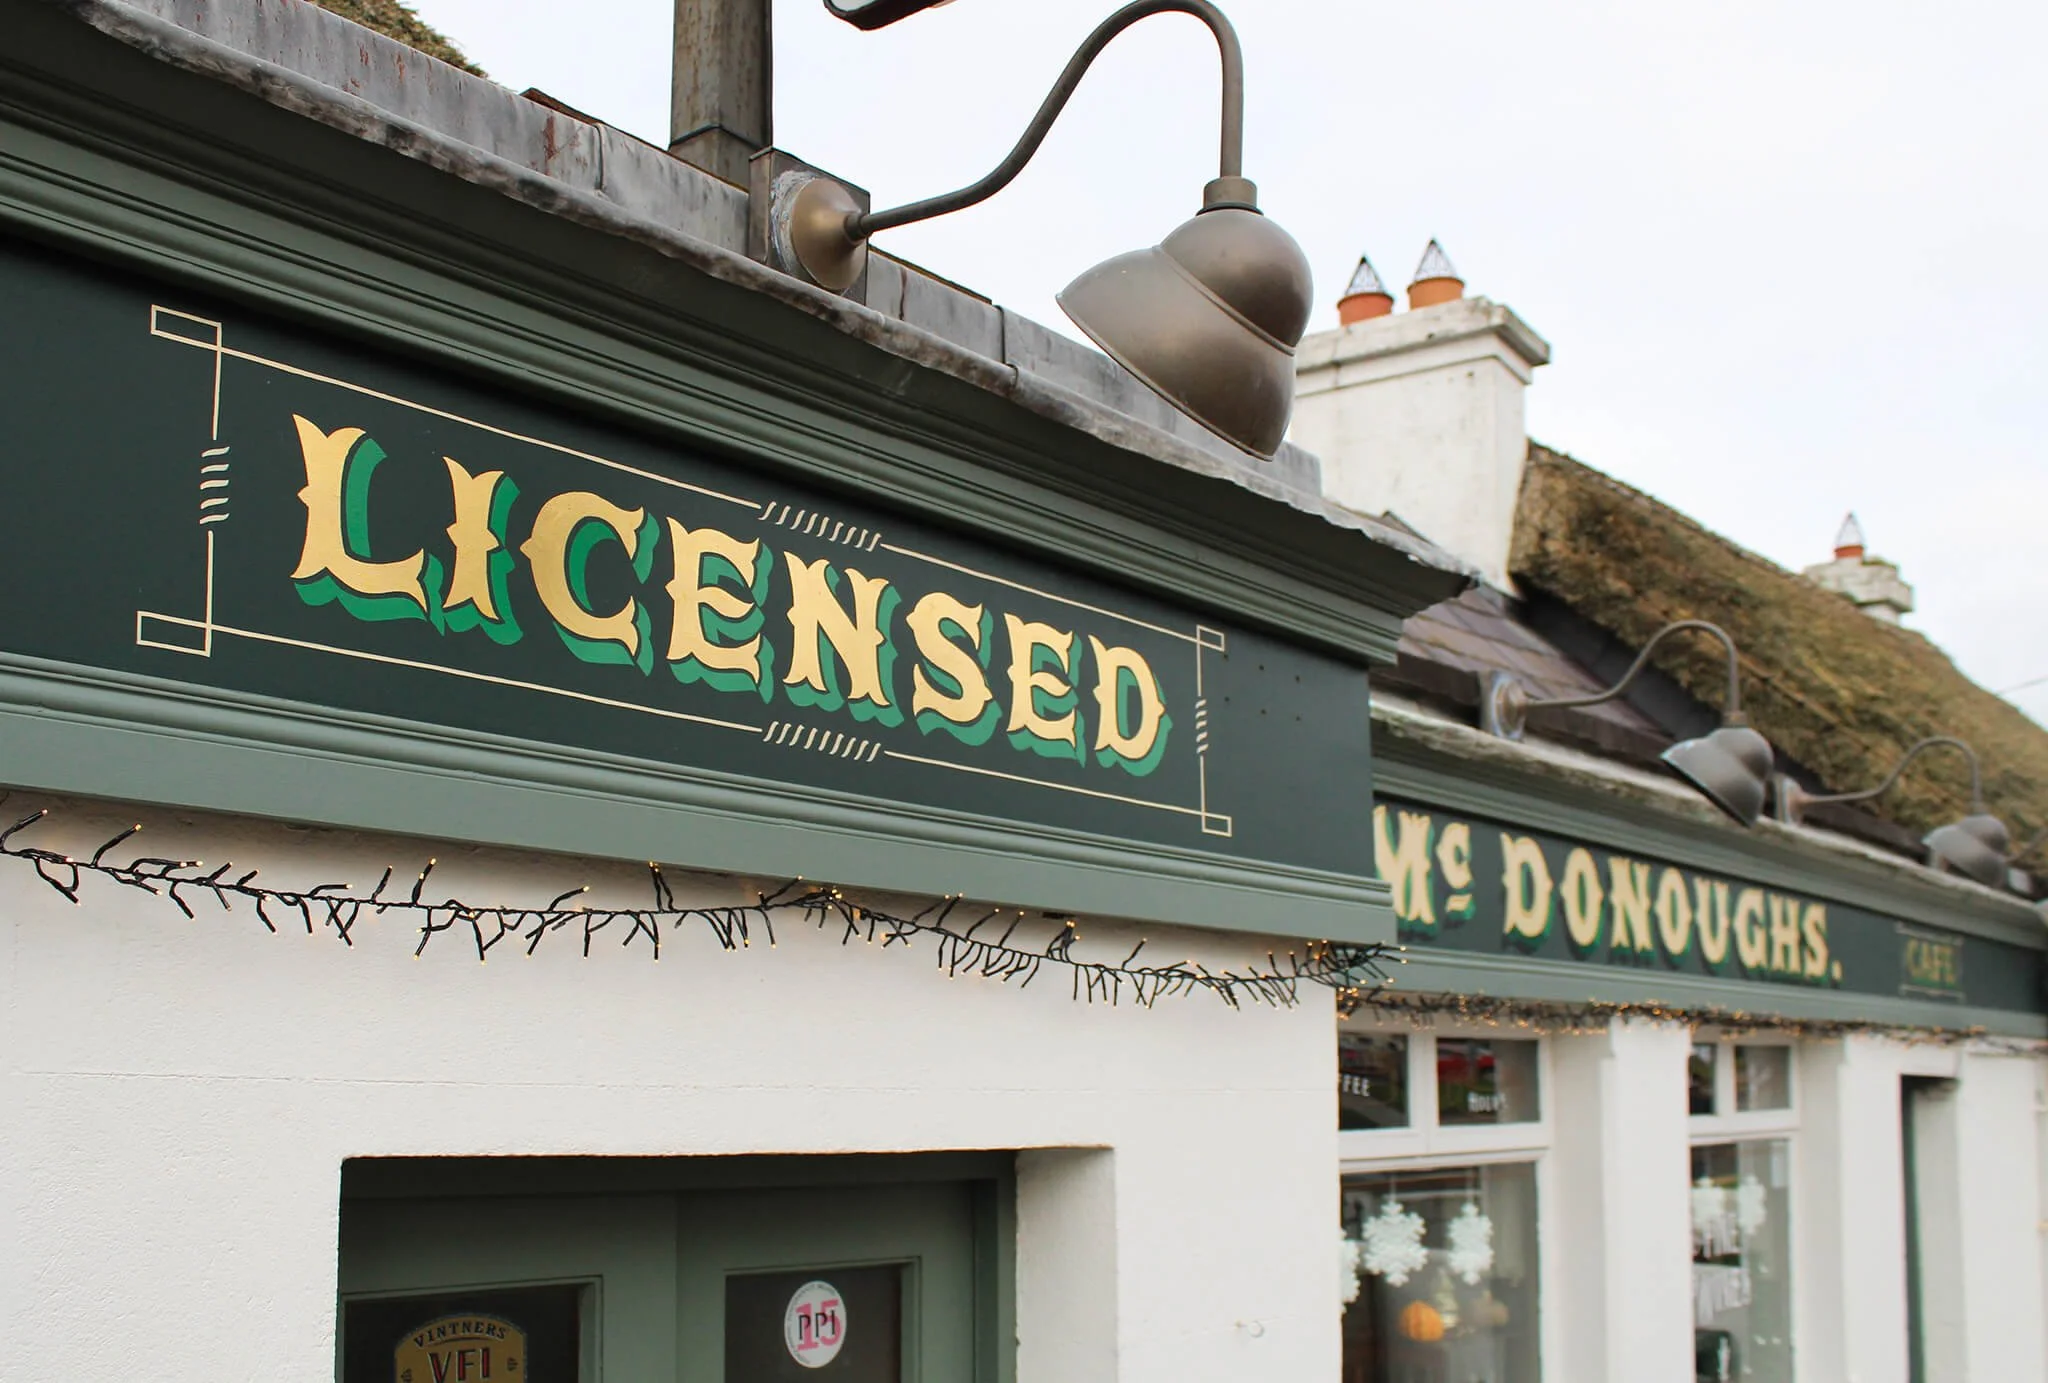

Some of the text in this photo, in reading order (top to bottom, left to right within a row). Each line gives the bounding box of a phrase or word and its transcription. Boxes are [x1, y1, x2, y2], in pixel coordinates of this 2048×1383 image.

[291, 413, 1170, 774] LICENSED
[1500, 832, 1843, 983] DONOUGHS.
[413, 1321, 507, 1348] VINTNERS
[799, 1309, 836, 1341] PPI
[427, 1346, 491, 1383] VFI
